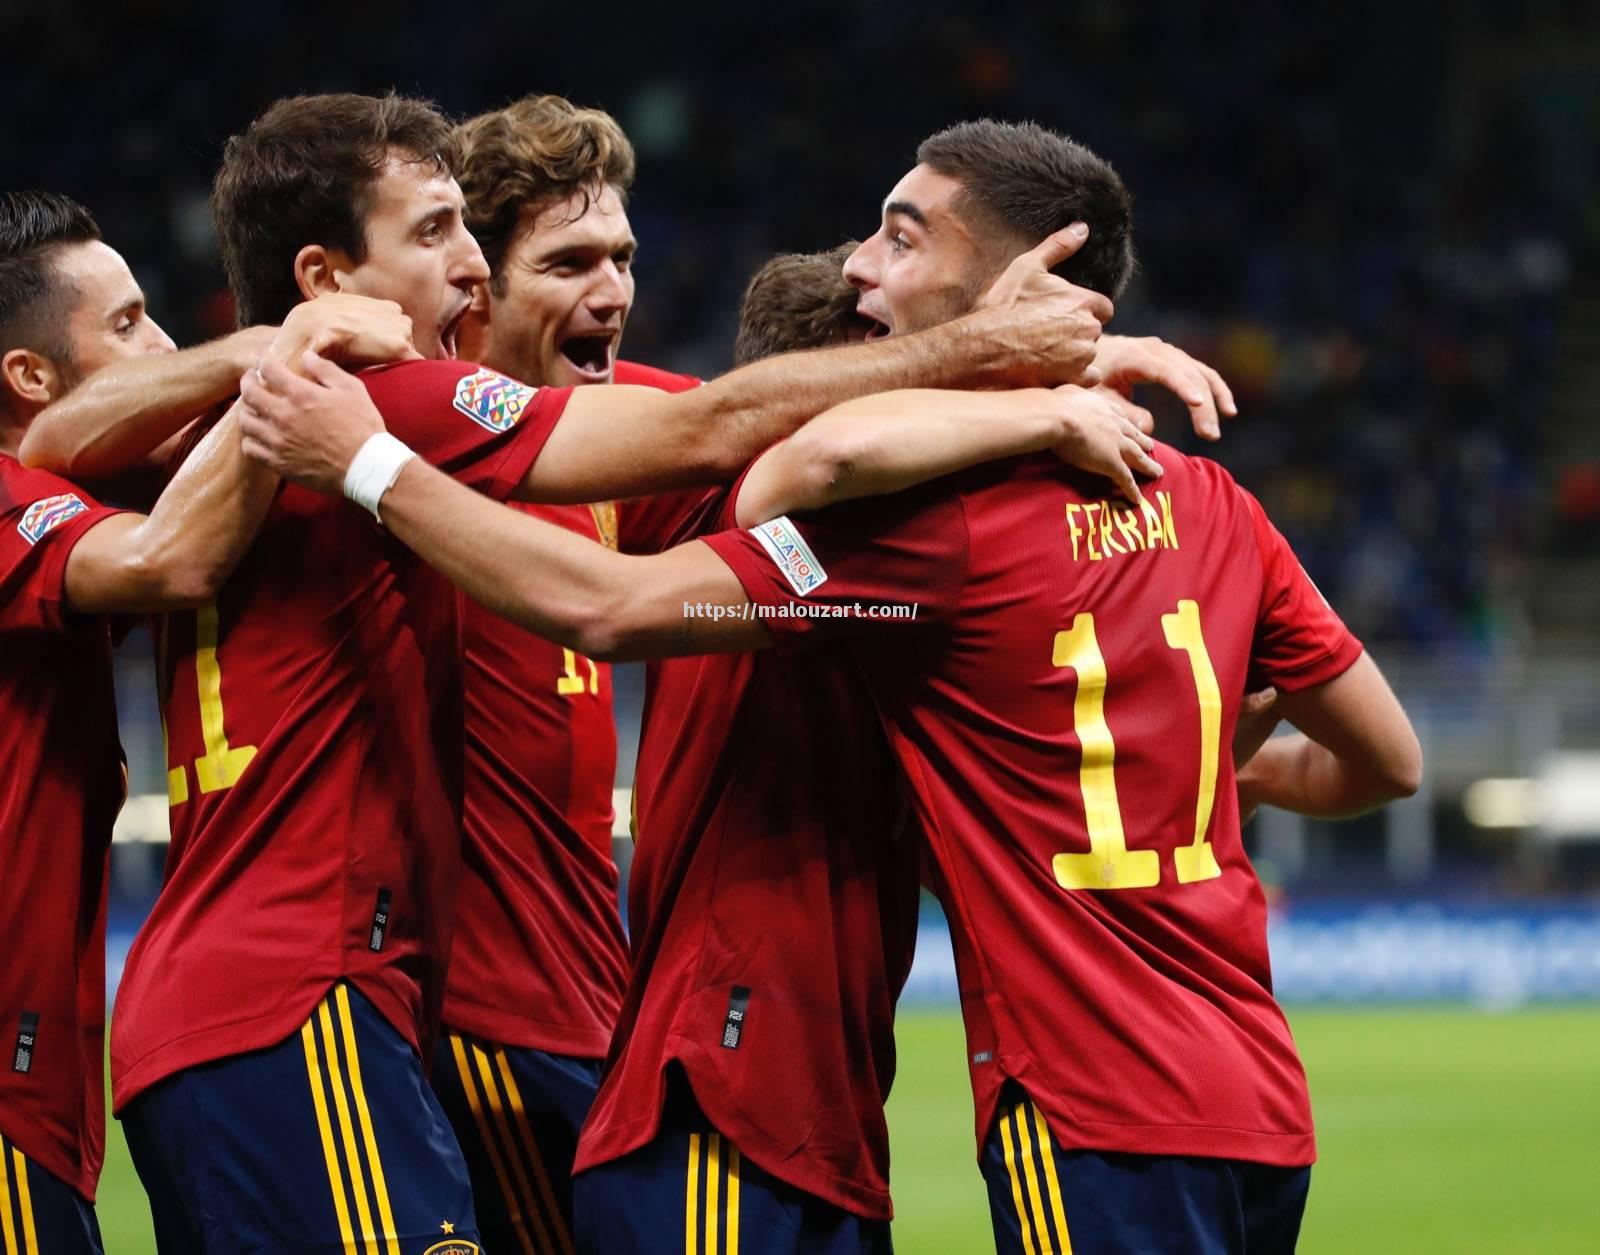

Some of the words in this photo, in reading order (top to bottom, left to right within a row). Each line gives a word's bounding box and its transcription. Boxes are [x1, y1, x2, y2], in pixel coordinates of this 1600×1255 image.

[767, 522, 818, 588] NDATION
[1065, 491, 1179, 561] FERRAN
[1052, 599, 1222, 889] 11
